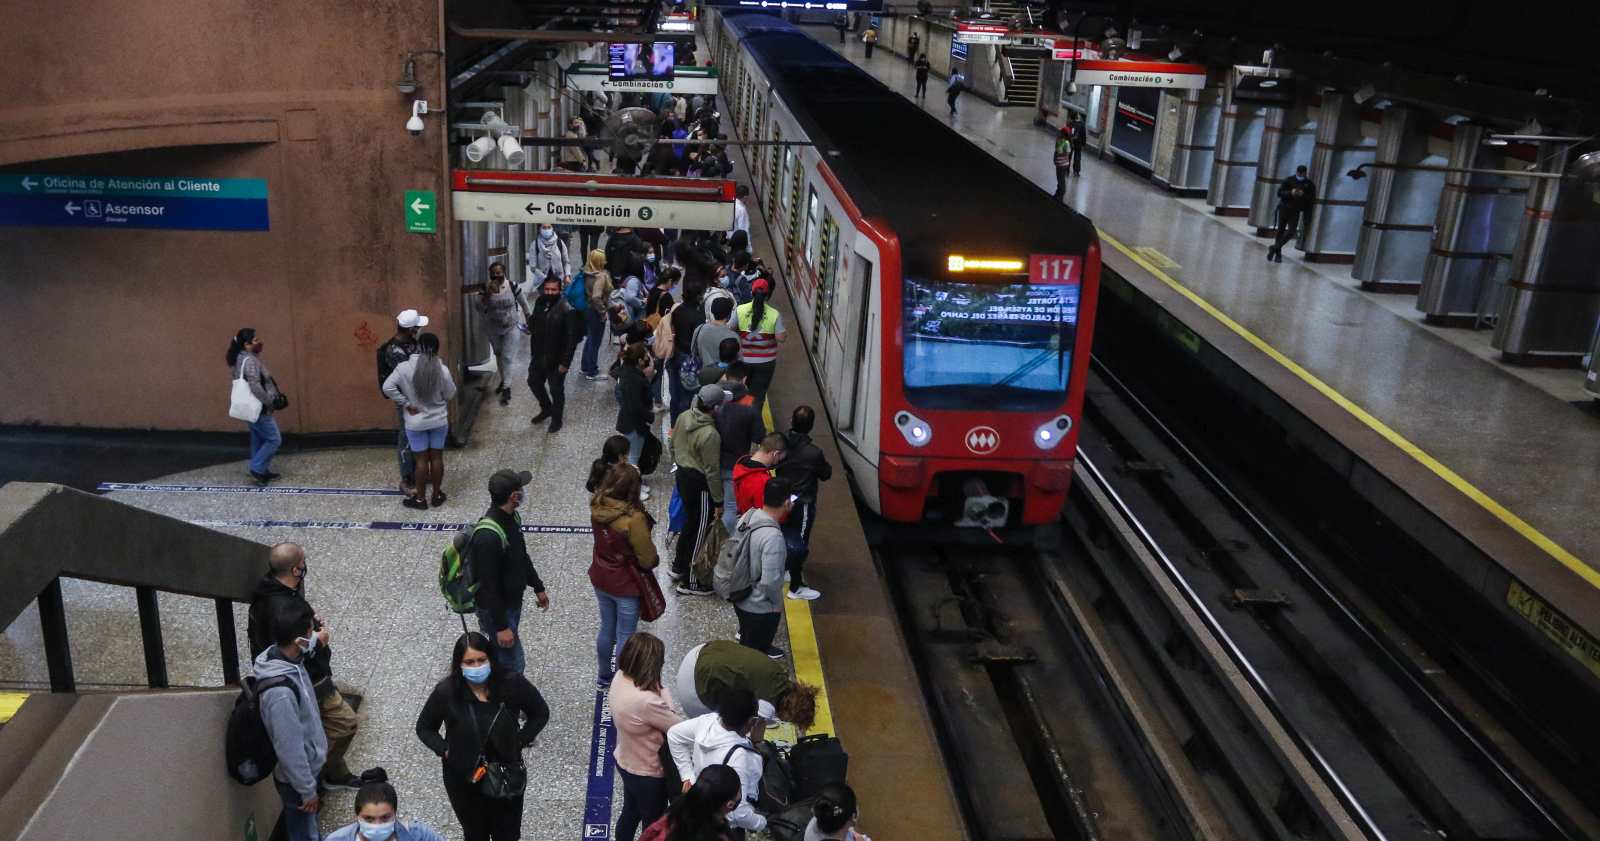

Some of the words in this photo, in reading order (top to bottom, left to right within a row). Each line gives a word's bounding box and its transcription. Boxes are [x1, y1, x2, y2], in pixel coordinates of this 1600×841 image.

[44, 177, 86, 189] Oficina
[90, 178, 104, 189] de
[108, 178, 160, 191] Atención
[164, 180, 175, 191] al
[178, 180, 220, 192] Cliente
[105, 203, 165, 216] Ascensor
[546, 201, 631, 218] Combinación
[1040, 259, 1074, 280] 117
